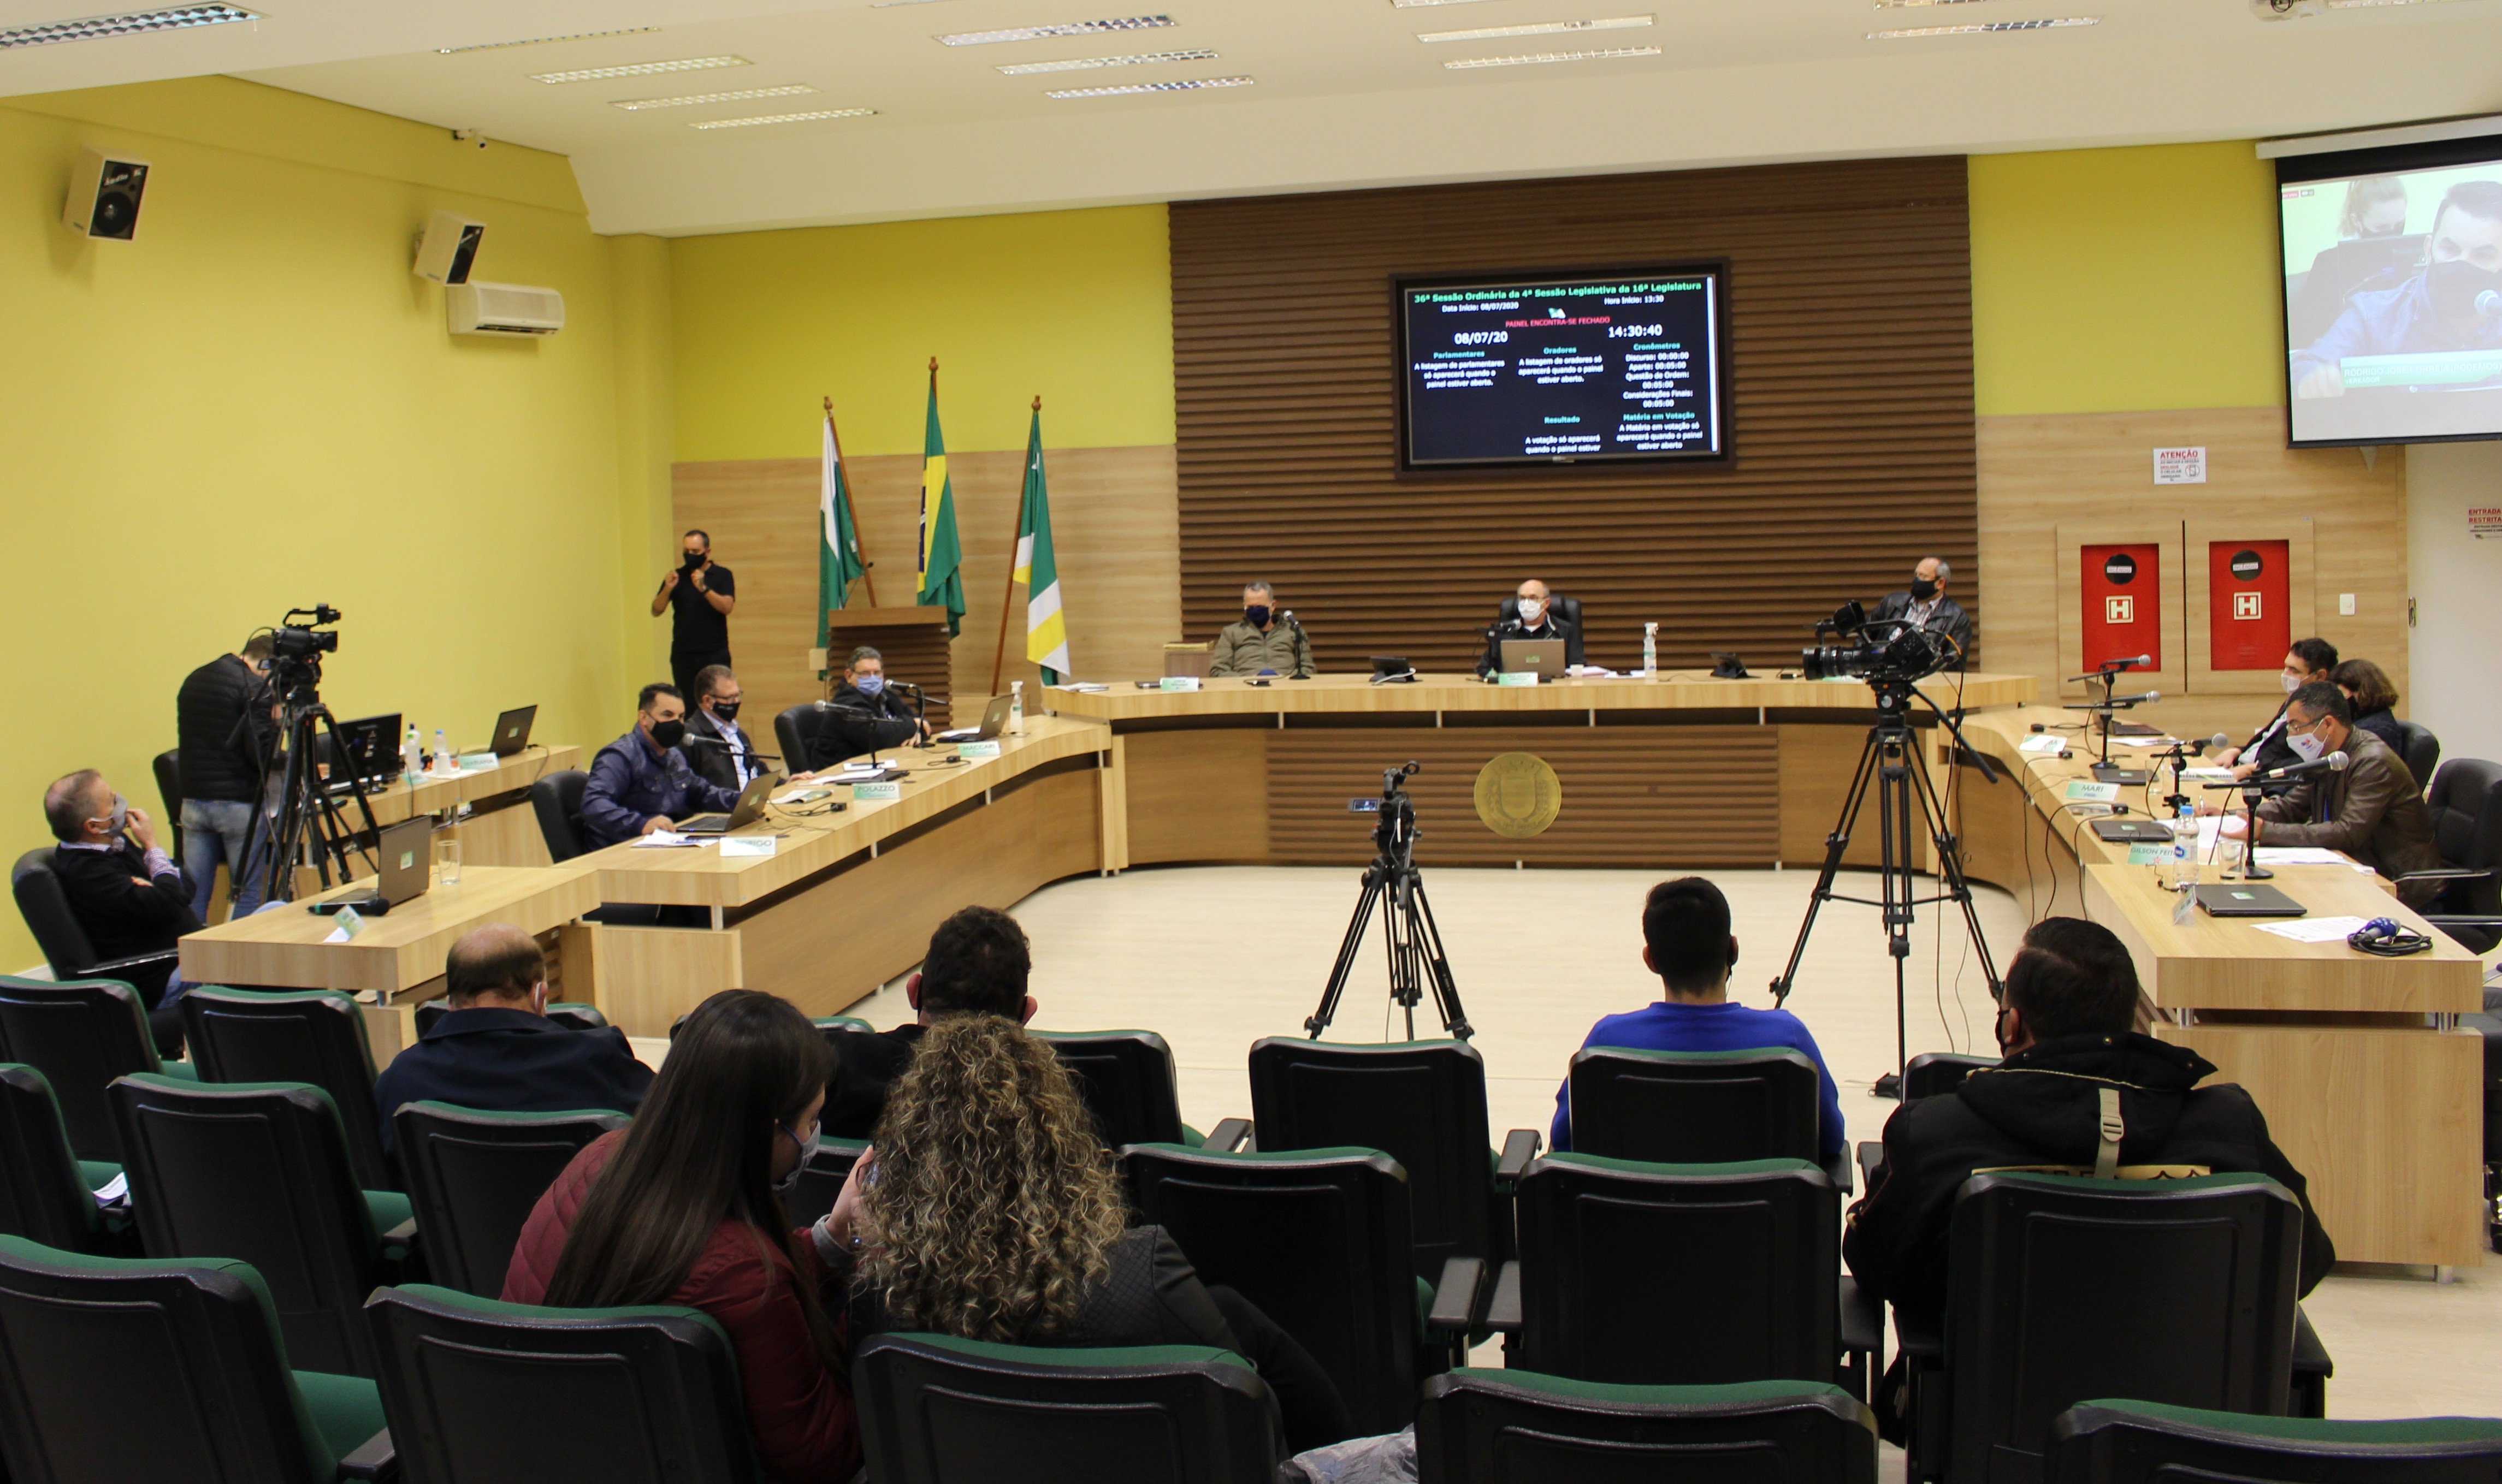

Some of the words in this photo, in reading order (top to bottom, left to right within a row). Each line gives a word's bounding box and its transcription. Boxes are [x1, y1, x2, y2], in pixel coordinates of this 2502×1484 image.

[1415, 295, 1430, 303] 36ª
[1432, 294, 1463, 302] Sessão
[1465, 290, 1506, 301] Ordinária
[1509, 290, 1519, 299] da
[1522, 289, 1533, 298] 4ª
[1535, 287, 1566, 297] Sessão
[1568, 286, 1617, 296] Legislativa
[1618, 284, 1630, 294] da
[1632, 283, 1648, 292] 16ª
[1651, 282, 1701, 292] Legislatura
[1604, 296, 1620, 305] Hora
[1644, 295, 1664, 304] 13:30
[1480, 301, 1519, 311] 08/07/2020
[1530, 318, 1577, 327] ENCONTRA-SE
[1578, 316, 1611, 324] FECHADO
[1607, 324, 1663, 338] 14:30:40
[1454, 331, 1509, 345] 08/07/20
[1543, 347, 1577, 355] Oradores
[1632, 342, 1681, 351] Cronômetros
[1433, 351, 1486, 359] Parlamentares
[1625, 354, 1657, 362] Discurso:
[1657, 351, 1690, 361] 00:00:00
[1421, 363, 1448, 371] listagem
[1458, 360, 1505, 370] parlamentares
[1518, 358, 1525, 366] A
[1525, 358, 1554, 367] listagem
[1554, 357, 1563, 365] de
[1564, 356, 1593, 364] oradores
[1594, 354, 1603, 363] só
[1518, 366, 1551, 376] aparecerá
[1551, 366, 1577, 375] quando
[1583, 364, 1604, 374] painel
[1628, 363, 1654, 372] Aparte:
[1654, 361, 1687, 370] 00:05:00
[1433, 370, 1465, 379] aparecerá
[1465, 369, 1490, 378] quando
[1625, 372, 1653, 382] Questão
[1654, 371, 1664, 379] de
[1664, 371, 1689, 379] Ordem:
[2344, 367, 2383, 377] RODRIGO
[1426, 381, 1446, 389] painel
[1642, 381, 1674, 389] 00:05:00
[1623, 390, 1670, 400] Considerações
[1642, 399, 1675, 408] 00:05:00
[1544, 415, 1581, 424] Resultado
[1623, 413, 1651, 421] Matéria
[1665, 411, 1695, 420] Votação
[1625, 423, 1651, 431] Matéria
[1664, 422, 1690, 431] votação
[1690, 421, 1700, 430] só
[1531, 435, 1558, 445] votação
[1558, 435, 1567, 443] só
[1568, 434, 1601, 444] aparecerá
[1616, 432, 1649, 442] aparecerá
[1649, 432, 1676, 441] quando
[1682, 431, 1704, 441] painel
[1525, 446, 1551, 455] quando
[1557, 444, 1578, 454] painel
[1578, 444, 1601, 452] estiver
[1660, 441, 1683, 449] aberto
[2160, 449, 2198, 459] ATENÇÃO
